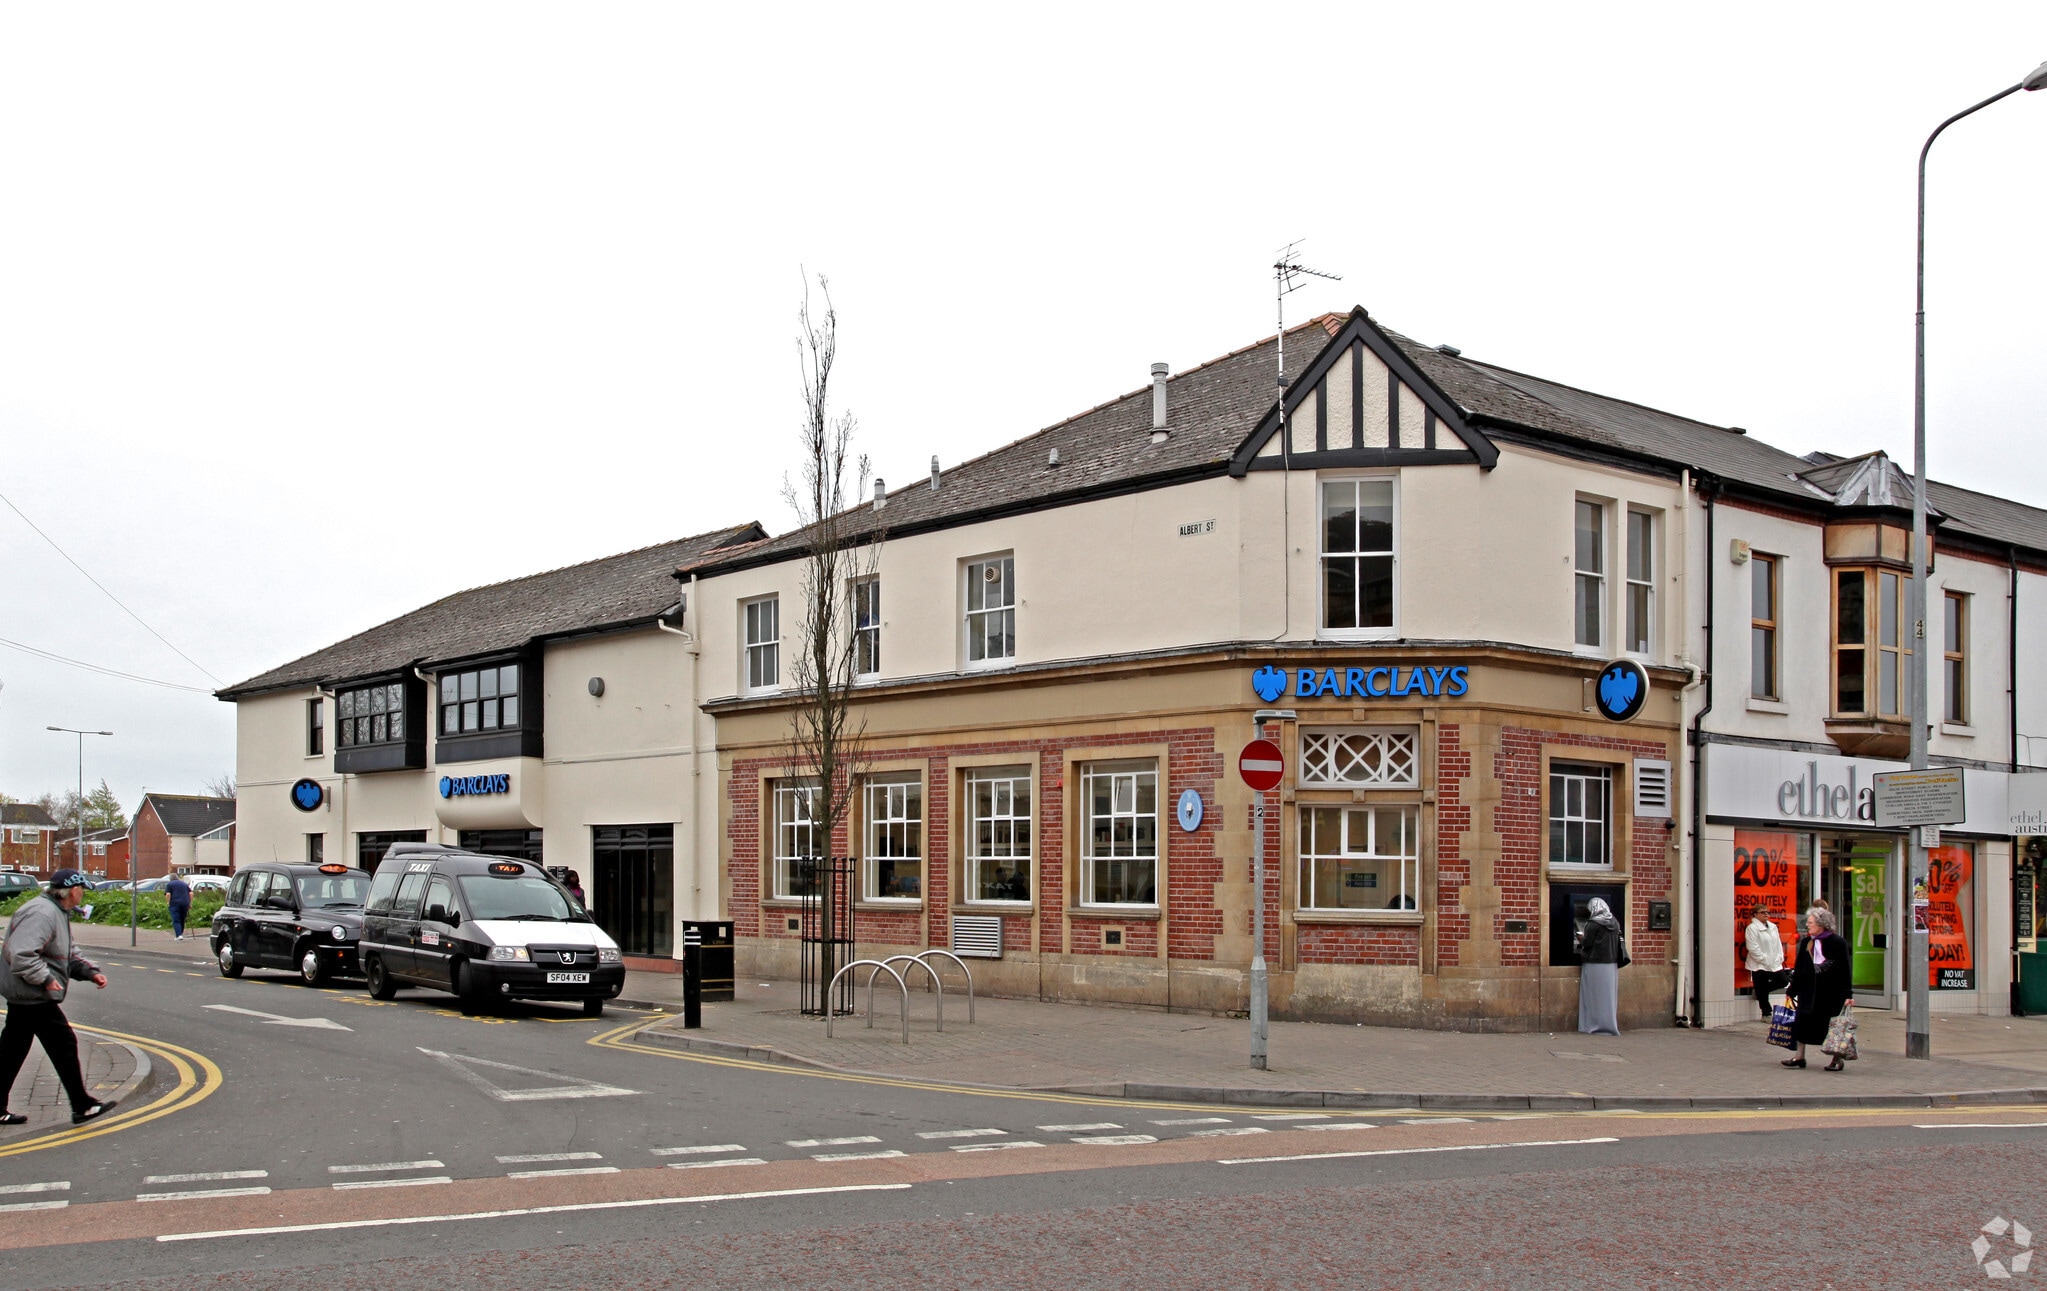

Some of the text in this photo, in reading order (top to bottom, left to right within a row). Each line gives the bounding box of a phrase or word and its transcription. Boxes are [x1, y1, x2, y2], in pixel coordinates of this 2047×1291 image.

[1180, 524, 1202, 536] ALBERT
[1295, 666, 1469, 698] BARCLAYS
[452, 774, 509, 795] BARCLAYS
[1778, 760, 1857, 820] ethel
[1257, 808, 1264, 817] 2
[2010, 810, 2041, 824] ethel
[2015, 822, 2047, 834] austi
[408, 863, 431, 872] TAXI
[1734, 847, 1788, 887] 20%
[1770, 874, 1788, 887] OFF
[1928, 859, 1962, 894] 0%
[1928, 944, 1966, 961] ODAY!
[1941, 979, 1968, 987] INCREASE
